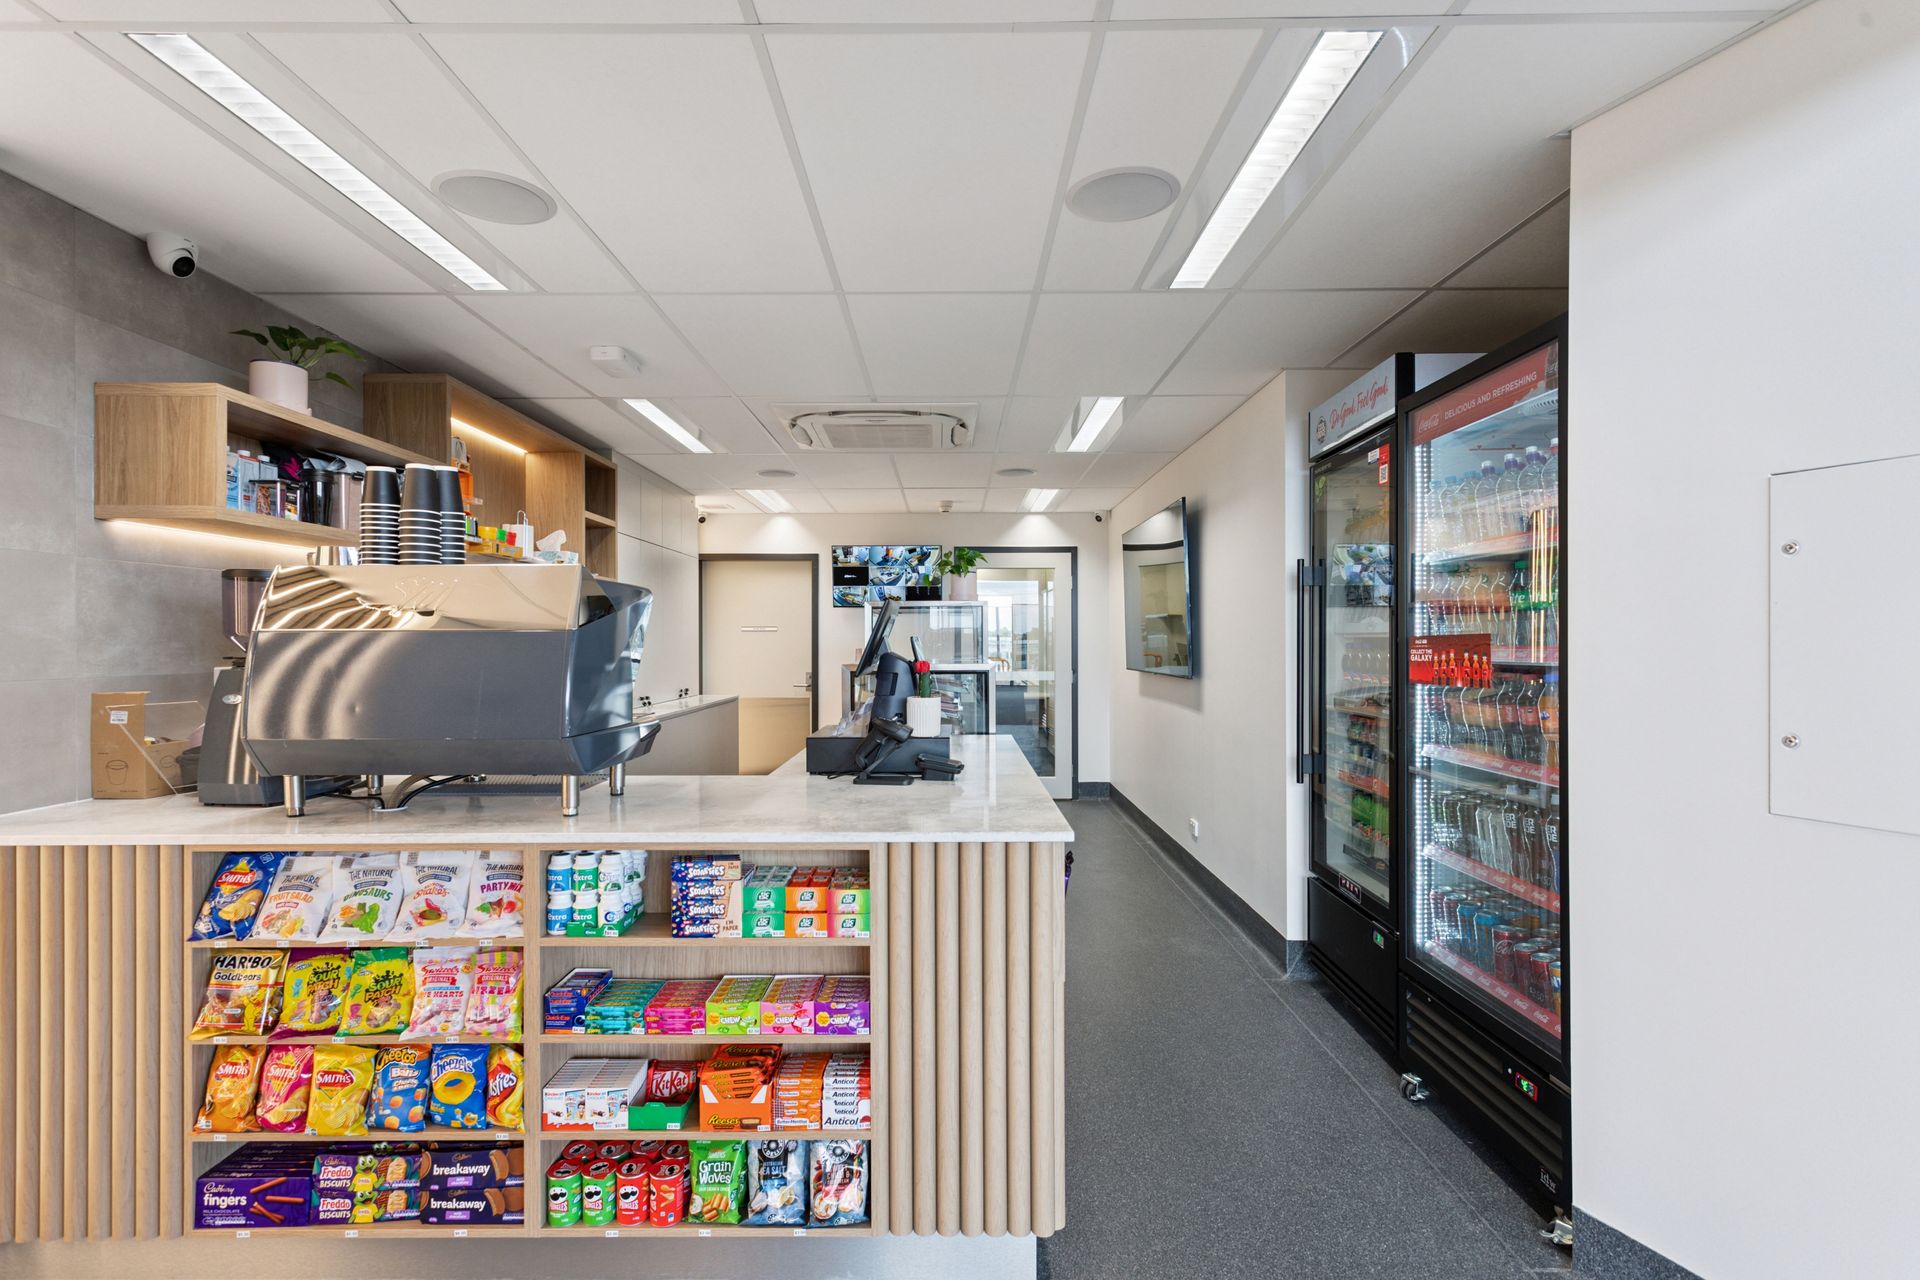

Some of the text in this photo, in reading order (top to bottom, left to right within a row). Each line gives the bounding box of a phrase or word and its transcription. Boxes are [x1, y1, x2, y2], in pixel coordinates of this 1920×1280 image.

[1444, 371, 1537, 419] DELICIOUS AND REFRESHING
[349, 868, 394, 880] THE NATURAL
[480, 881, 524, 894] PARTY MIX
[269, 891, 314, 904] FRUIT SALAD
[343, 887, 394, 902] DINOSAURS
[215, 956, 273, 969] HARIBO
[214, 972, 261, 981] Goldbears
[309, 969, 340, 983] SOUR
[369, 975, 403, 991] SOUR
[365, 985, 403, 1002] PATCH
[720, 1016, 741, 1024] CHEW
[775, 1016, 795, 1024] CHEW
[830, 1016, 850, 1024] CHEW
[375, 1047, 416, 1072] Cheetos
[432, 1056, 475, 1081] Cheezels
[654, 1071, 688, 1096] KitKat
[824, 1117, 859, 1125] Anticol
[766, 1147, 781, 1157] DELI
[321, 1166, 352, 1178] Freddo
[433, 1163, 490, 1176] breakaway
[699, 1160, 732, 1173] Grain
[771, 1166, 786, 1174] SALT
[320, 1180, 351, 1188] BISCUITS
[699, 1172, 731, 1185] Waves
[203, 1182, 235, 1194] Cadbury
[203, 1194, 247, 1209] fingers
[320, 1199, 351, 1210] Freddo
[430, 1198, 486, 1212] breakaway
[319, 1211, 351, 1219] BISCUITS
